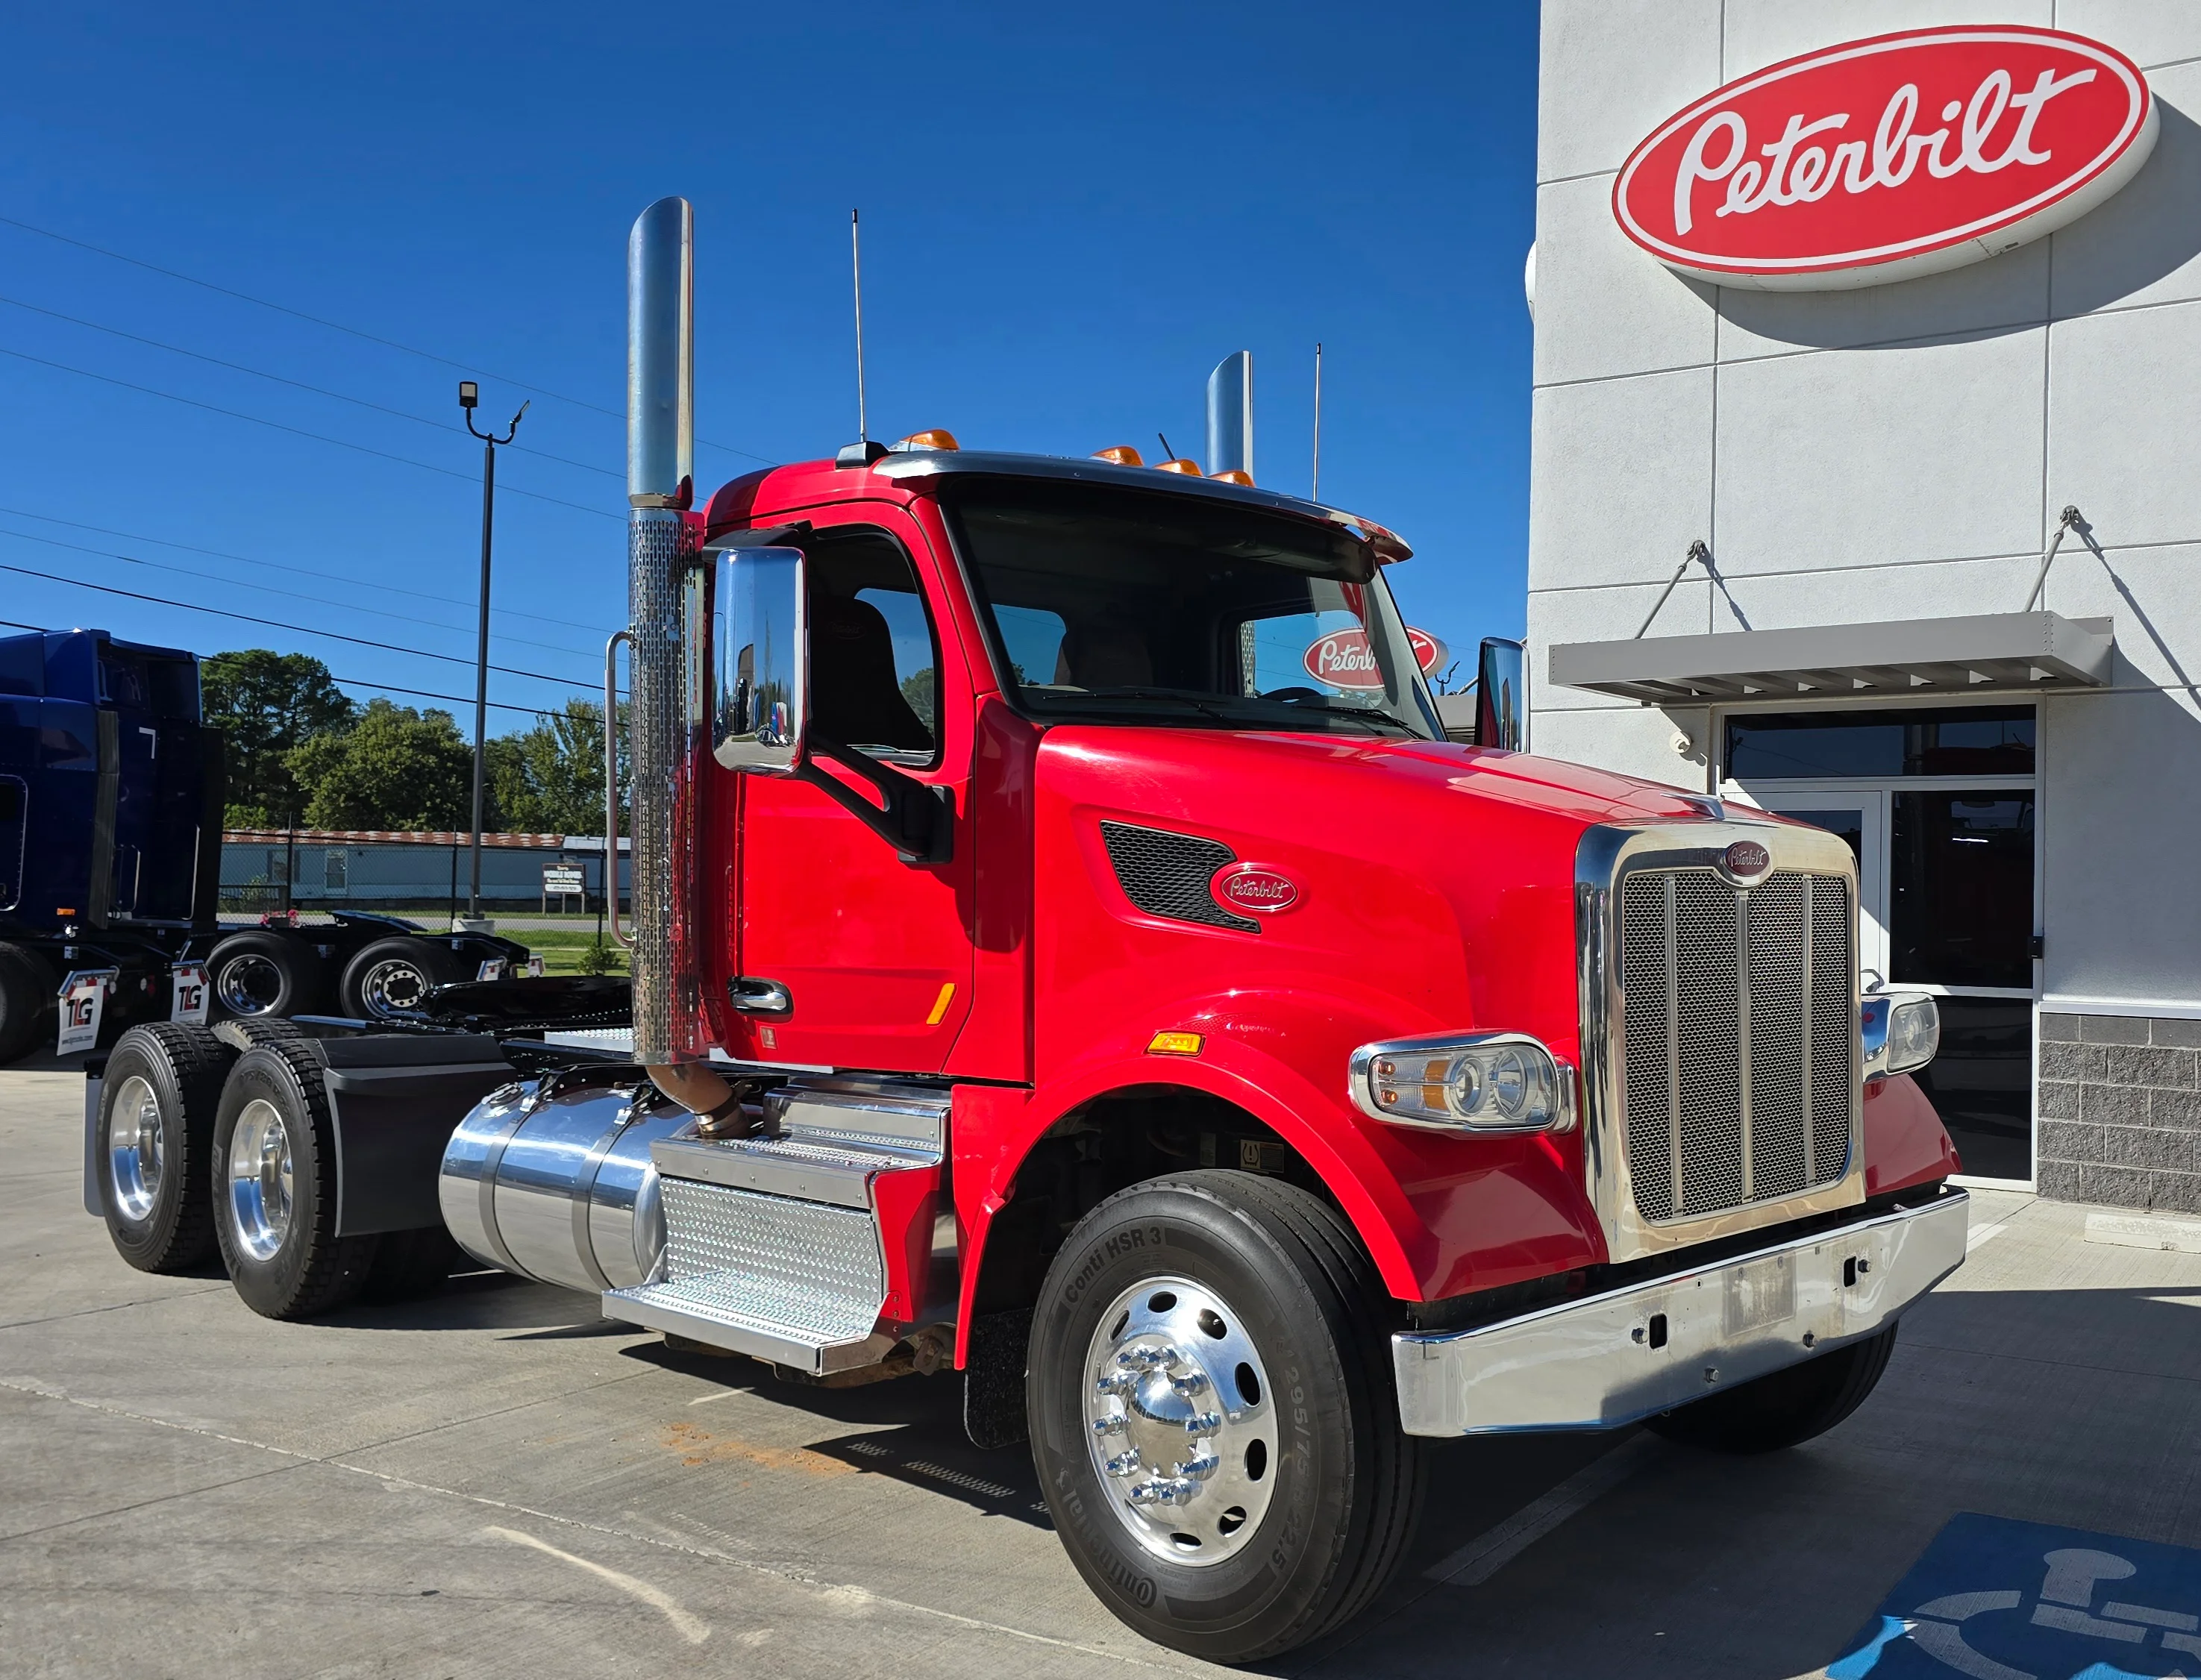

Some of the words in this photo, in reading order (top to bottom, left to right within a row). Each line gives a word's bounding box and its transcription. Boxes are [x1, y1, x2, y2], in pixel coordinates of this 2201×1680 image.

[1674, 68, 2097, 236] Peterbilt
[1731, 847, 1766, 868] Peterbilt
[1230, 877, 1289, 899] Peterbilt
[66, 997, 94, 1027] TLG
[178, 985, 201, 1012] TLG
[1065, 1247, 1106, 1304] Conti
[1105, 1228, 1146, 1260] HSR
[1149, 1226, 1162, 1246] 3
[1283, 1365, 1311, 1476] 295/75
[1062, 1488, 1158, 1609] Continental
[1271, 1508, 1303, 1568] 22.5
